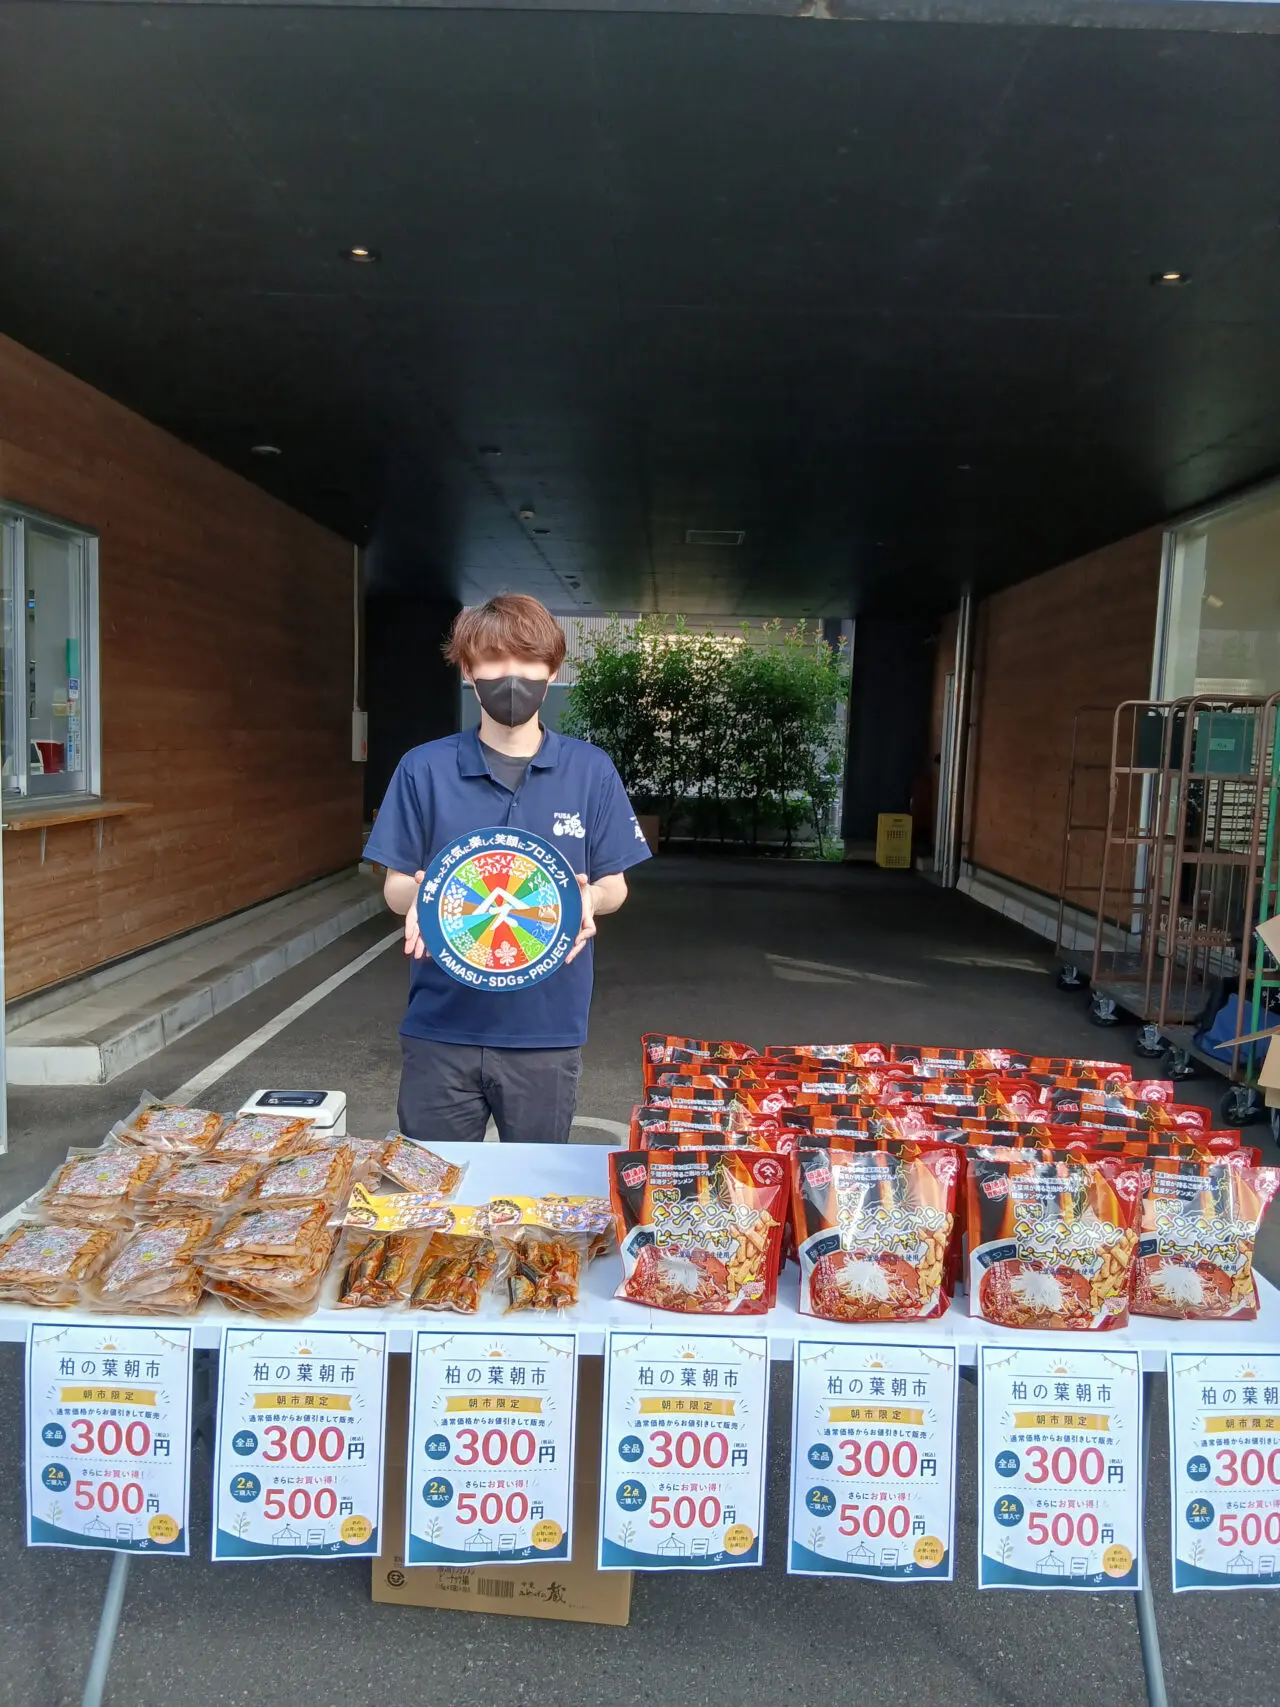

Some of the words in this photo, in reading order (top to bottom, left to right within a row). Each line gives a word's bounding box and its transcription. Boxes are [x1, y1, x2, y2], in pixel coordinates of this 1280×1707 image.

[437, 932, 572, 988] YAMASU-SDGs-PROJECT
[653, 1204, 759, 1227] タンタンメン
[59, 1357, 161, 1378] 柏の葉朝市
[253, 1363, 356, 1382] 柏の葉朝市
[445, 1365, 546, 1385] 柏の葉朝市
[638, 1366, 738, 1388] 柏の葉朝市
[827, 1376, 927, 1397] 柏の葉朝市
[1012, 1381, 1111, 1402] 柏の葉朝市
[83, 1390, 134, 1400] 朝市限定
[276, 1396, 328, 1406] 朝市限定
[468, 1399, 520, 1408] 朝市限定
[661, 1400, 713, 1411] 朝市限定
[56, 1408, 160, 1420] 通常価格からお値引きして販売
[249, 1415, 354, 1424] 通常価格からお値引きして販売
[851, 1409, 901, 1420] 朝市限定
[441, 1418, 545, 1427] 通常価格からお値引きして販売
[634, 1420, 738, 1430] 通常価格からお値引きして販売
[1036, 1415, 1087, 1426] 朝市限定
[1226, 1419, 1275, 1429] 朝市限定
[44, 1430, 63, 1439] 全品
[824, 1428, 927, 1439] 通常価格からお値引きして販売
[235, 1438, 254, 1448] 全品
[1010, 1435, 1113, 1445] 通常価格からお値引きして販売
[428, 1442, 447, 1452] 全品
[622, 1444, 640, 1453] 全品
[811, 1451, 829, 1461] 全品
[998, 1459, 1016, 1468] 全品
[1190, 1464, 1207, 1473] 全品
[48, 1468, 64, 1479] 2点
[237, 1477, 254, 1489] 2点
[430, 1482, 446, 1494] 2点
[623, 1485, 639, 1497] 2点
[813, 1491, 828, 1503] 2点
[1000, 1500, 1017, 1512] 2点
[1192, 1504, 1208, 1515] 2点
